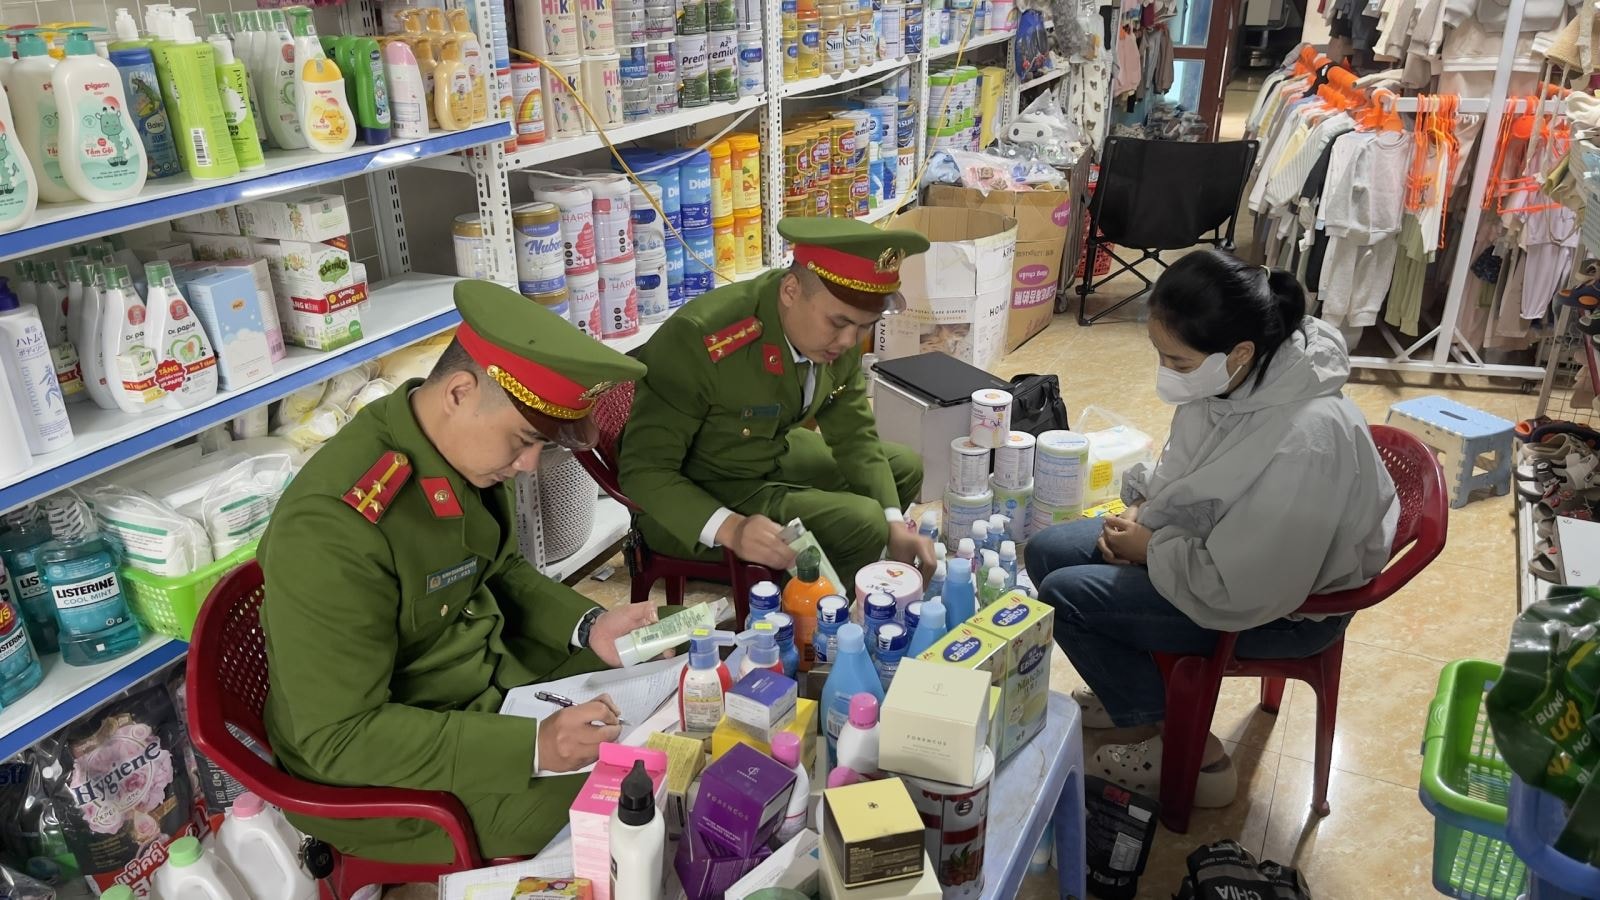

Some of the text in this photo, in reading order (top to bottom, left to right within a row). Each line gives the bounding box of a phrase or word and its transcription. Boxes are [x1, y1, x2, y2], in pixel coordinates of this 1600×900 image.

[84, 83, 110, 91] pigeon
[20, 576, 40, 589] LIS
[56, 576, 116, 599] LISTERINE
[63, 589, 113, 606] COOL MINT
[73, 741, 161, 806] Hygiene
